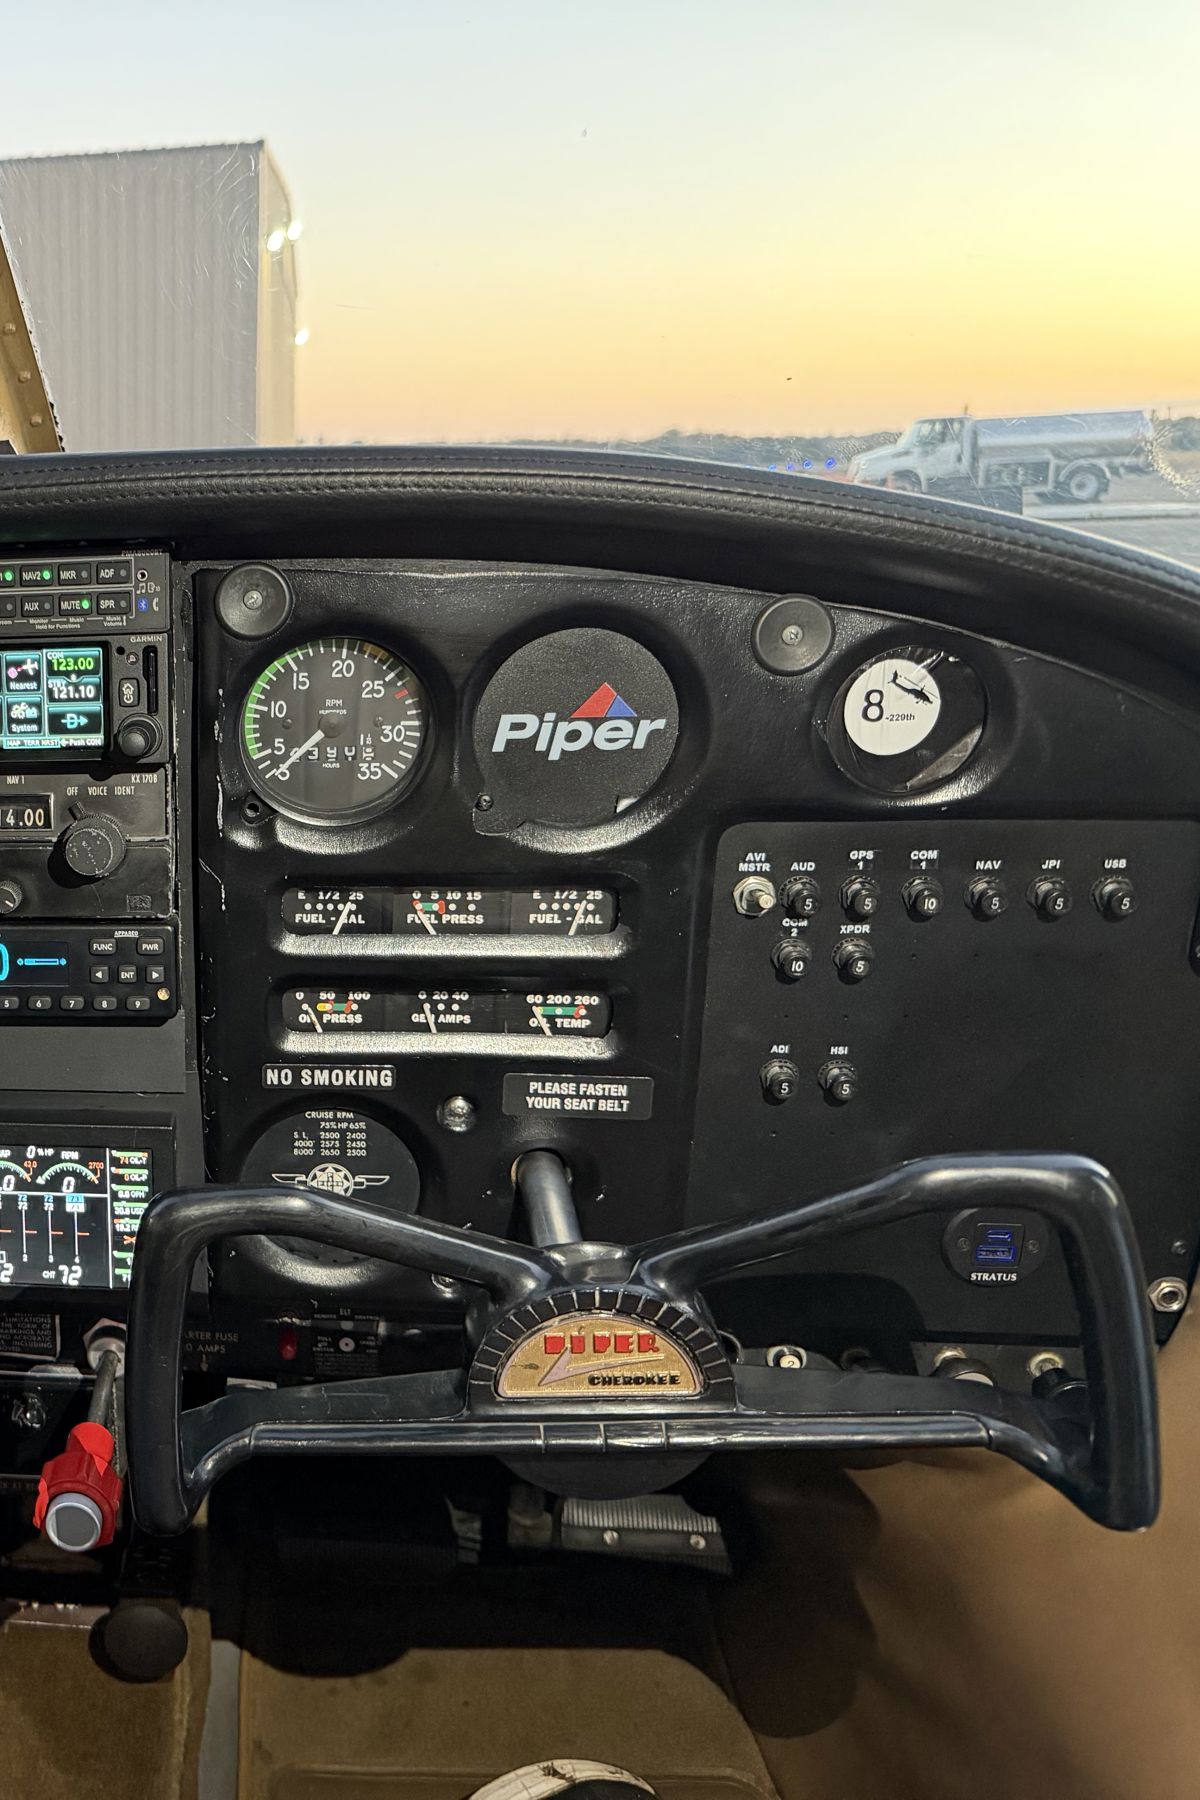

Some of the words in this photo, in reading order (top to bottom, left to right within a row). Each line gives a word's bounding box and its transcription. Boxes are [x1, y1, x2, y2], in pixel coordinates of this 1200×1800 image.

[23, 572, 41, 580] NAV2
[61, 570, 76, 579] MKR
[100, 569, 114, 578] ADF
[24, 602, 39, 610] AUX
[61, 601, 80, 609] MUTE
[100, 600, 114, 609] SPR
[130, 635, 162, 643] GARMIN
[52, 658, 94, 671] 123.00
[332, 660, 355, 677] 20
[293, 673, 309, 690] 15
[10, 682, 37, 691] Nearest
[362, 681, 385, 698] 25
[53, 685, 94, 698] 121.10
[271, 701, 286, 718] 10
[862, 689, 884, 722] 8
[12, 725, 38, 733] System
[381, 726, 405, 742] 30
[492, 713, 667, 760] Piper
[358, 763, 381, 780] 35
[7, 776, 19, 785] NAV
[67, 787, 78, 796] OFF
[87, 786, 107, 796] VOICE
[114, 785, 135, 796] IDENT
[745, 852, 765, 861] AVI
[849, 851, 873, 860] GPS
[911, 850, 938, 859] COM
[738, 863, 771, 872] MSTR
[791, 862, 816, 871] AUD
[975, 861, 1001, 870] NAV
[1041, 860, 1060, 870] JPI
[1104, 860, 1126, 869] USB
[295, 914, 325, 923] FUEL
[442, 914, 483, 925] PRESS
[529, 914, 561, 924] FUEL
[840, 925, 870, 934] XPDR
[93, 943, 112, 951] FUNC
[142, 943, 159, 951] PWR
[121, 971, 134, 979] ENT
[323, 1015, 362, 1024] PRESS
[438, 1015, 470, 1024] AMPS
[556, 1018, 590, 1028] TEMP
[266, 1069, 292, 1086] NO
[301, 1070, 392, 1087] SMOKING
[529, 1083, 576, 1095] PLEASE
[580, 1083, 627, 1097] FASTEN
[526, 1097, 561, 1110] YOUR
[564, 1098, 595, 1111] SEAT
[598, 1099, 629, 1112] BELT
[62, 1151, 78, 1159] RPM
[59, 1265, 81, 1285] 72
[970, 1272, 1017, 1281] STRATUS
[544, 1332, 660, 1354] PIPER
[196, 1344, 225, 1354] AMPS
[588, 1372, 680, 1386] CHEROKEE
